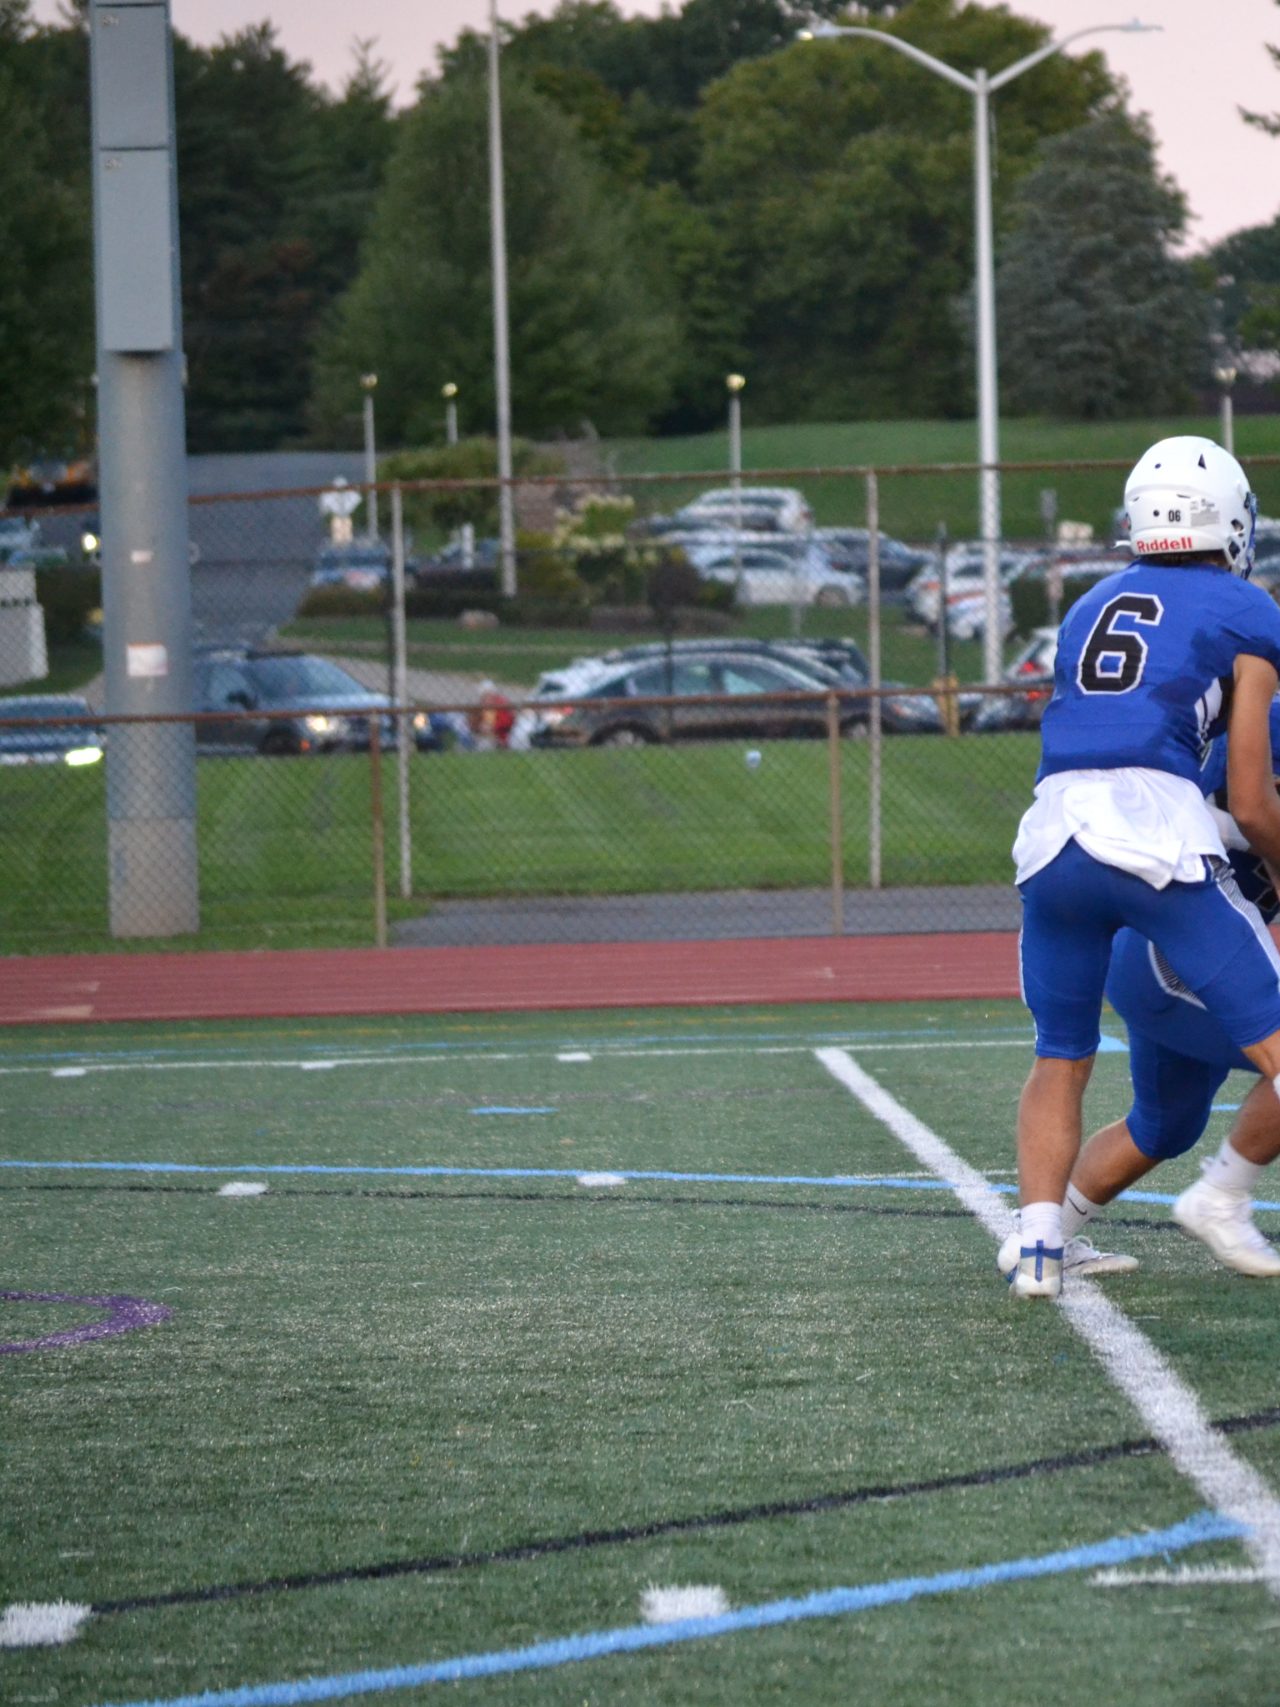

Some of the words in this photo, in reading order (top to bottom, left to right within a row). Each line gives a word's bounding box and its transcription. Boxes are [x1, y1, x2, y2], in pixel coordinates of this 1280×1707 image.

[1167, 510, 1181, 522] 06
[1136, 535, 1193, 553] Riddell
[1076, 592, 1165, 695] 6
